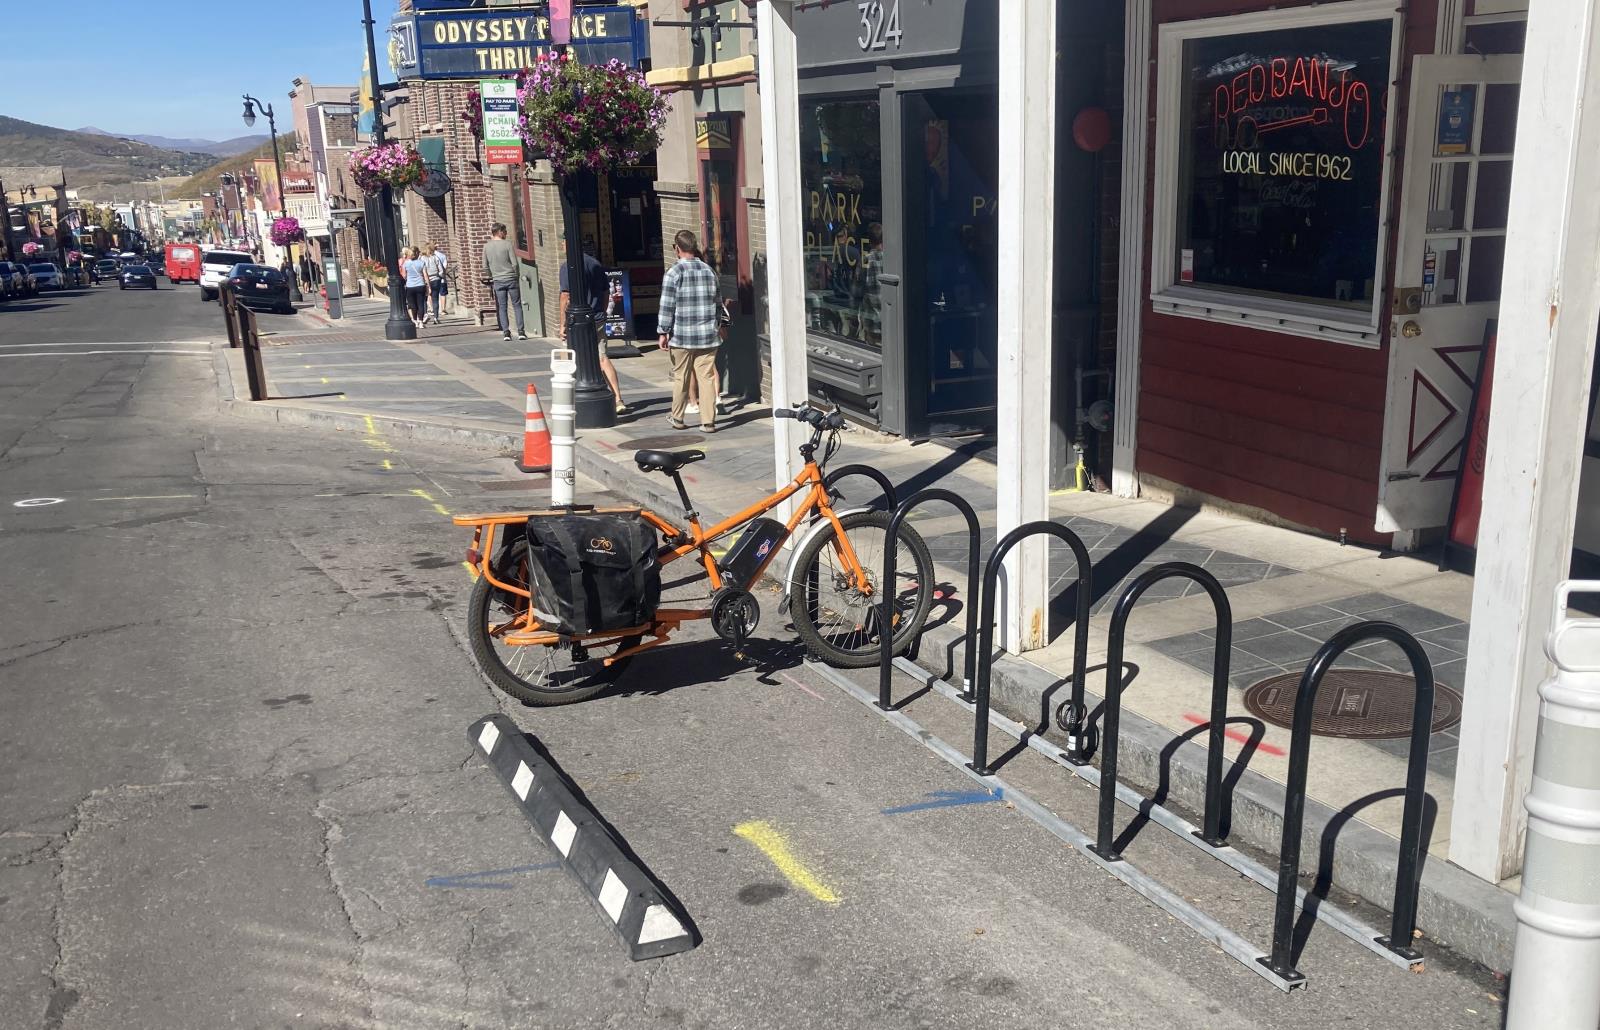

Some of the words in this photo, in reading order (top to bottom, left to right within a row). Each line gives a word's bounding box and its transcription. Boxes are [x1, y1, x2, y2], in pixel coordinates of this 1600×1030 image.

[434, 18, 527, 43] ODYSSEY
[536, 15, 607, 40] DNCE
[858, 0, 902, 49] 324
[1215, 64, 1266, 149] RED
[1271, 57, 1370, 149] BANJO
[488, 117, 516, 125] PCMAIN
[1223, 151, 1266, 175] LOCAL
[1269, 152, 1316, 177] SINCE
[1316, 152, 1352, 181] 1962
[811, 191, 862, 225] PARK
[806, 231, 871, 269] PLACE
